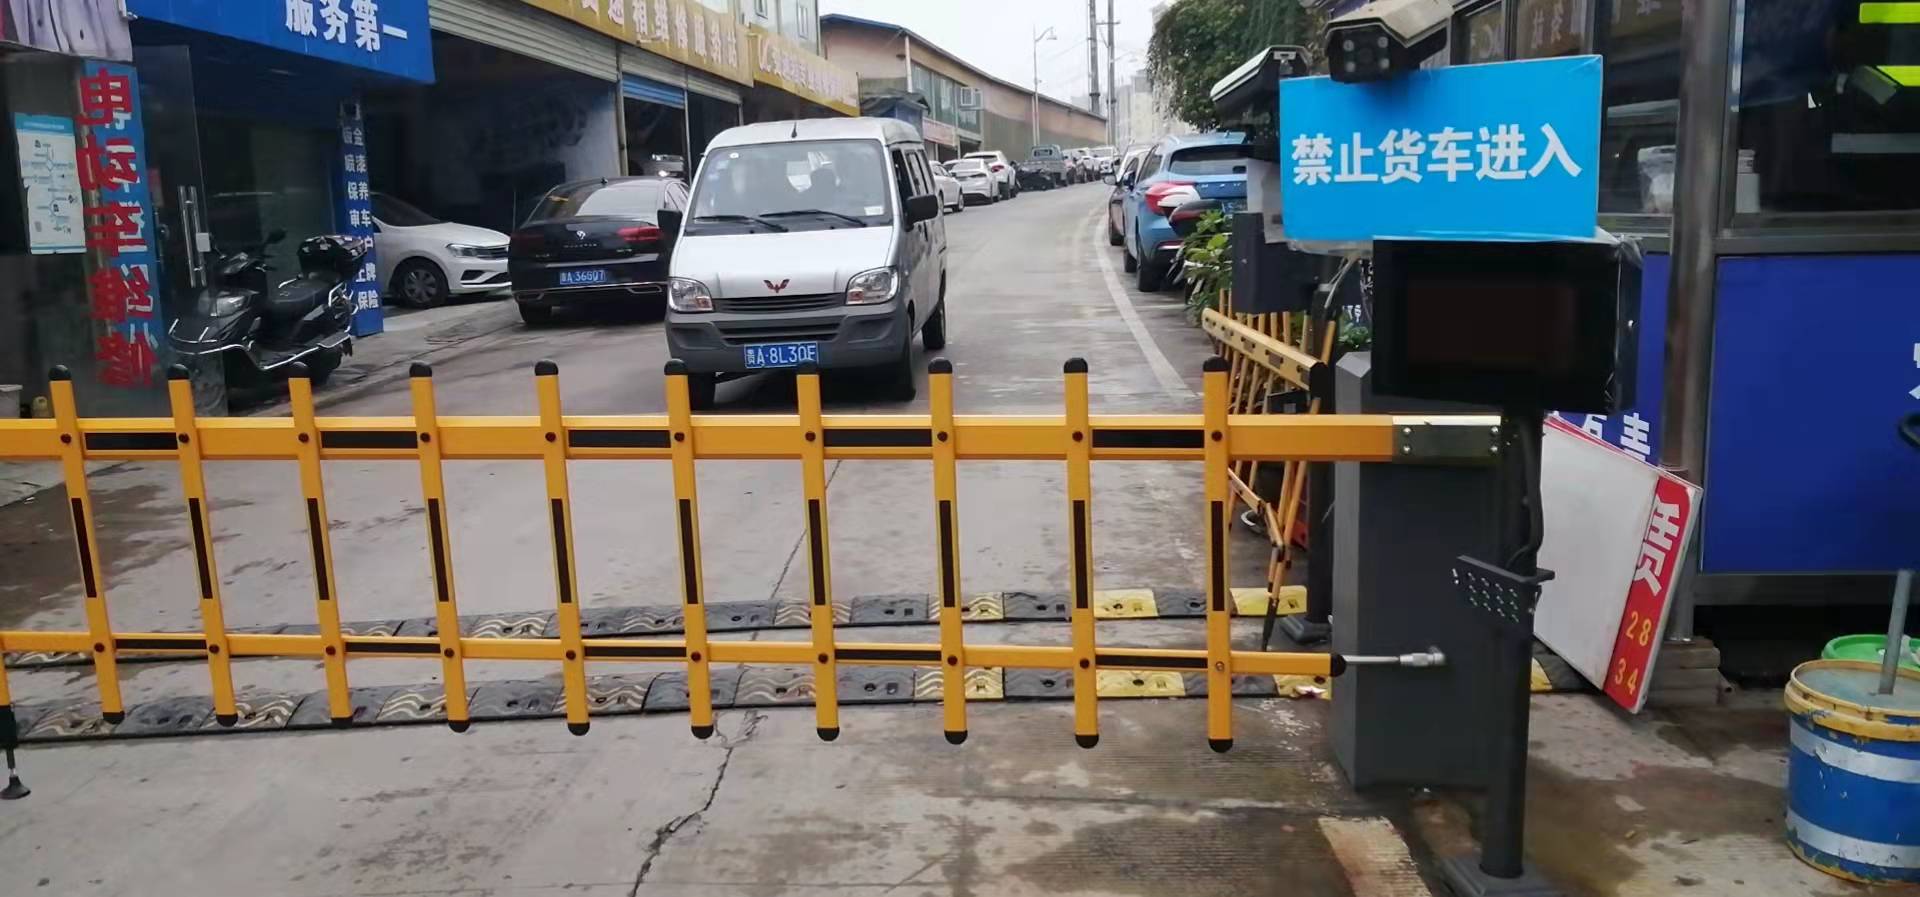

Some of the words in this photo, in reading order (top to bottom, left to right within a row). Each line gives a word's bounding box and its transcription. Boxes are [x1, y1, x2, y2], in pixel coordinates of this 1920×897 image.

[285, 0, 408, 52] 服务第一
[1292, 123, 1583, 186] 禁止货车进入
[347, 181, 369, 201] 保养
[349, 209, 371, 228] 审车
[357, 290, 379, 310] 保险
[1625, 611, 1652, 647] 28
[1614, 658, 1639, 696] 34
